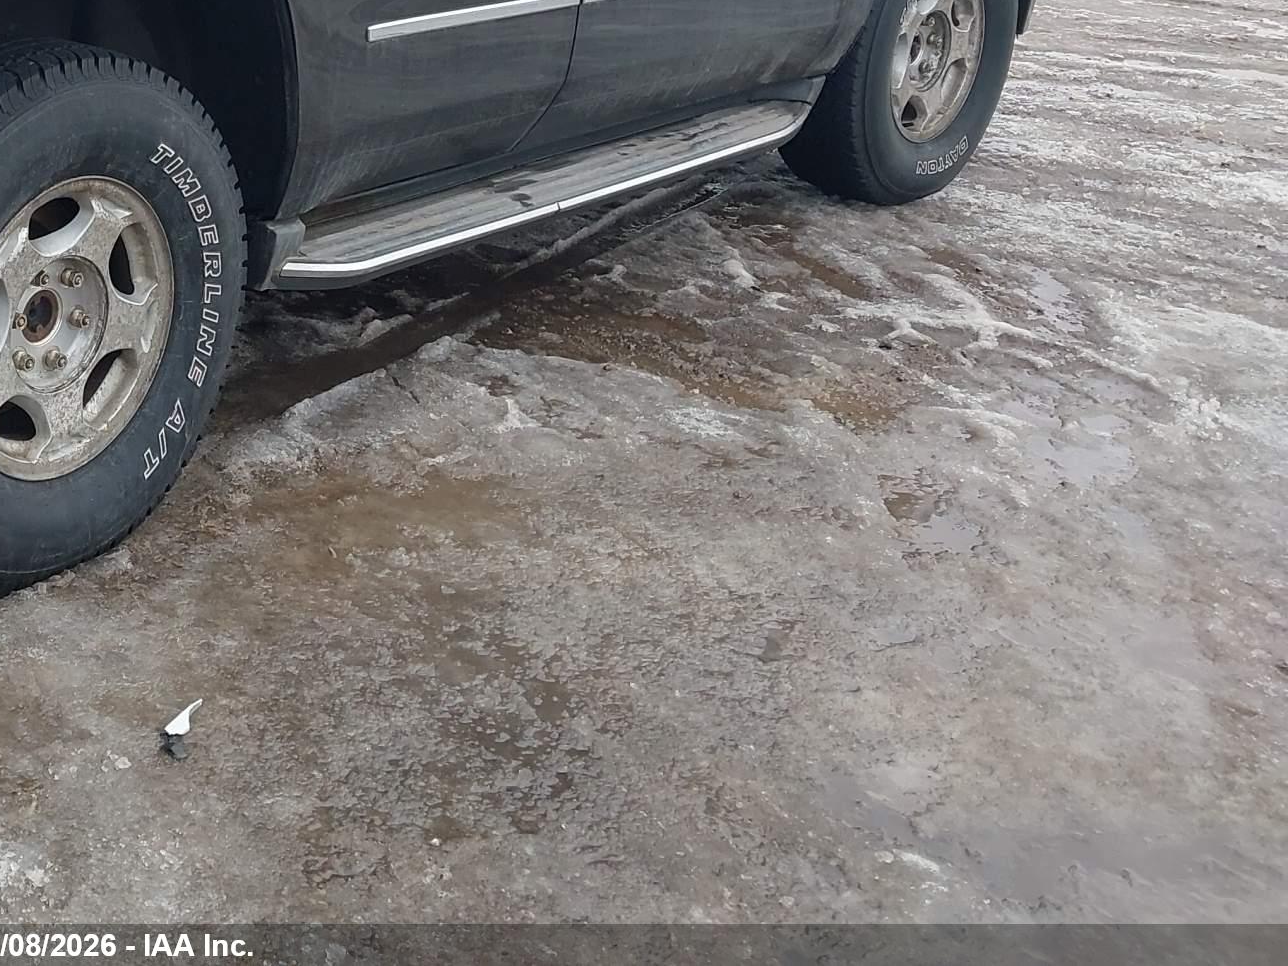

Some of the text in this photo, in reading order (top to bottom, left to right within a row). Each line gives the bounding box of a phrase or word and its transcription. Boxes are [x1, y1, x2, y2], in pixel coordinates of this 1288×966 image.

[915, 135, 969, 175] DAYTON
[142, 142, 224, 481] TIMBERLINE A/T
